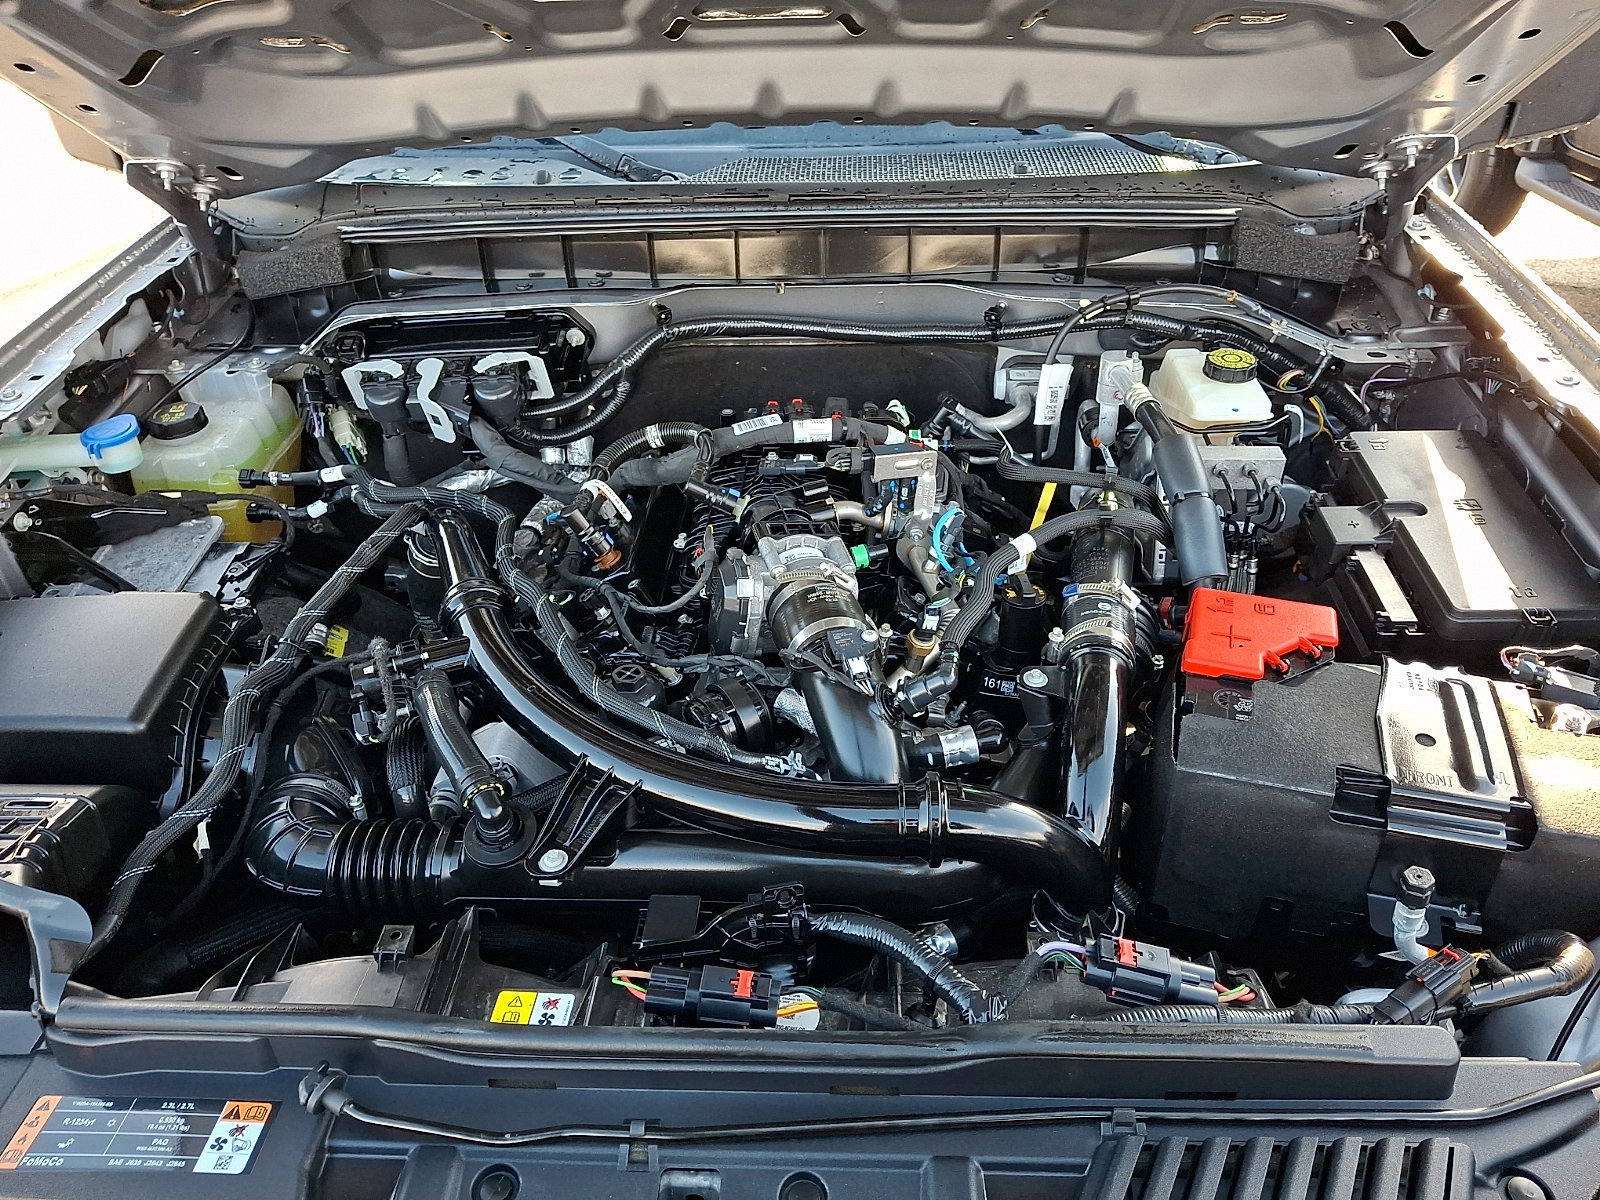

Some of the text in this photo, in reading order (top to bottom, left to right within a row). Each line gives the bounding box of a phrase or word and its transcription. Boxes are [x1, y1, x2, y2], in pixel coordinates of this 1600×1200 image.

[984, 676, 1001, 689] 161
[62, 1117, 97, 1127] R-1234yf
[20, 1156, 64, 1166] FoMoCo
